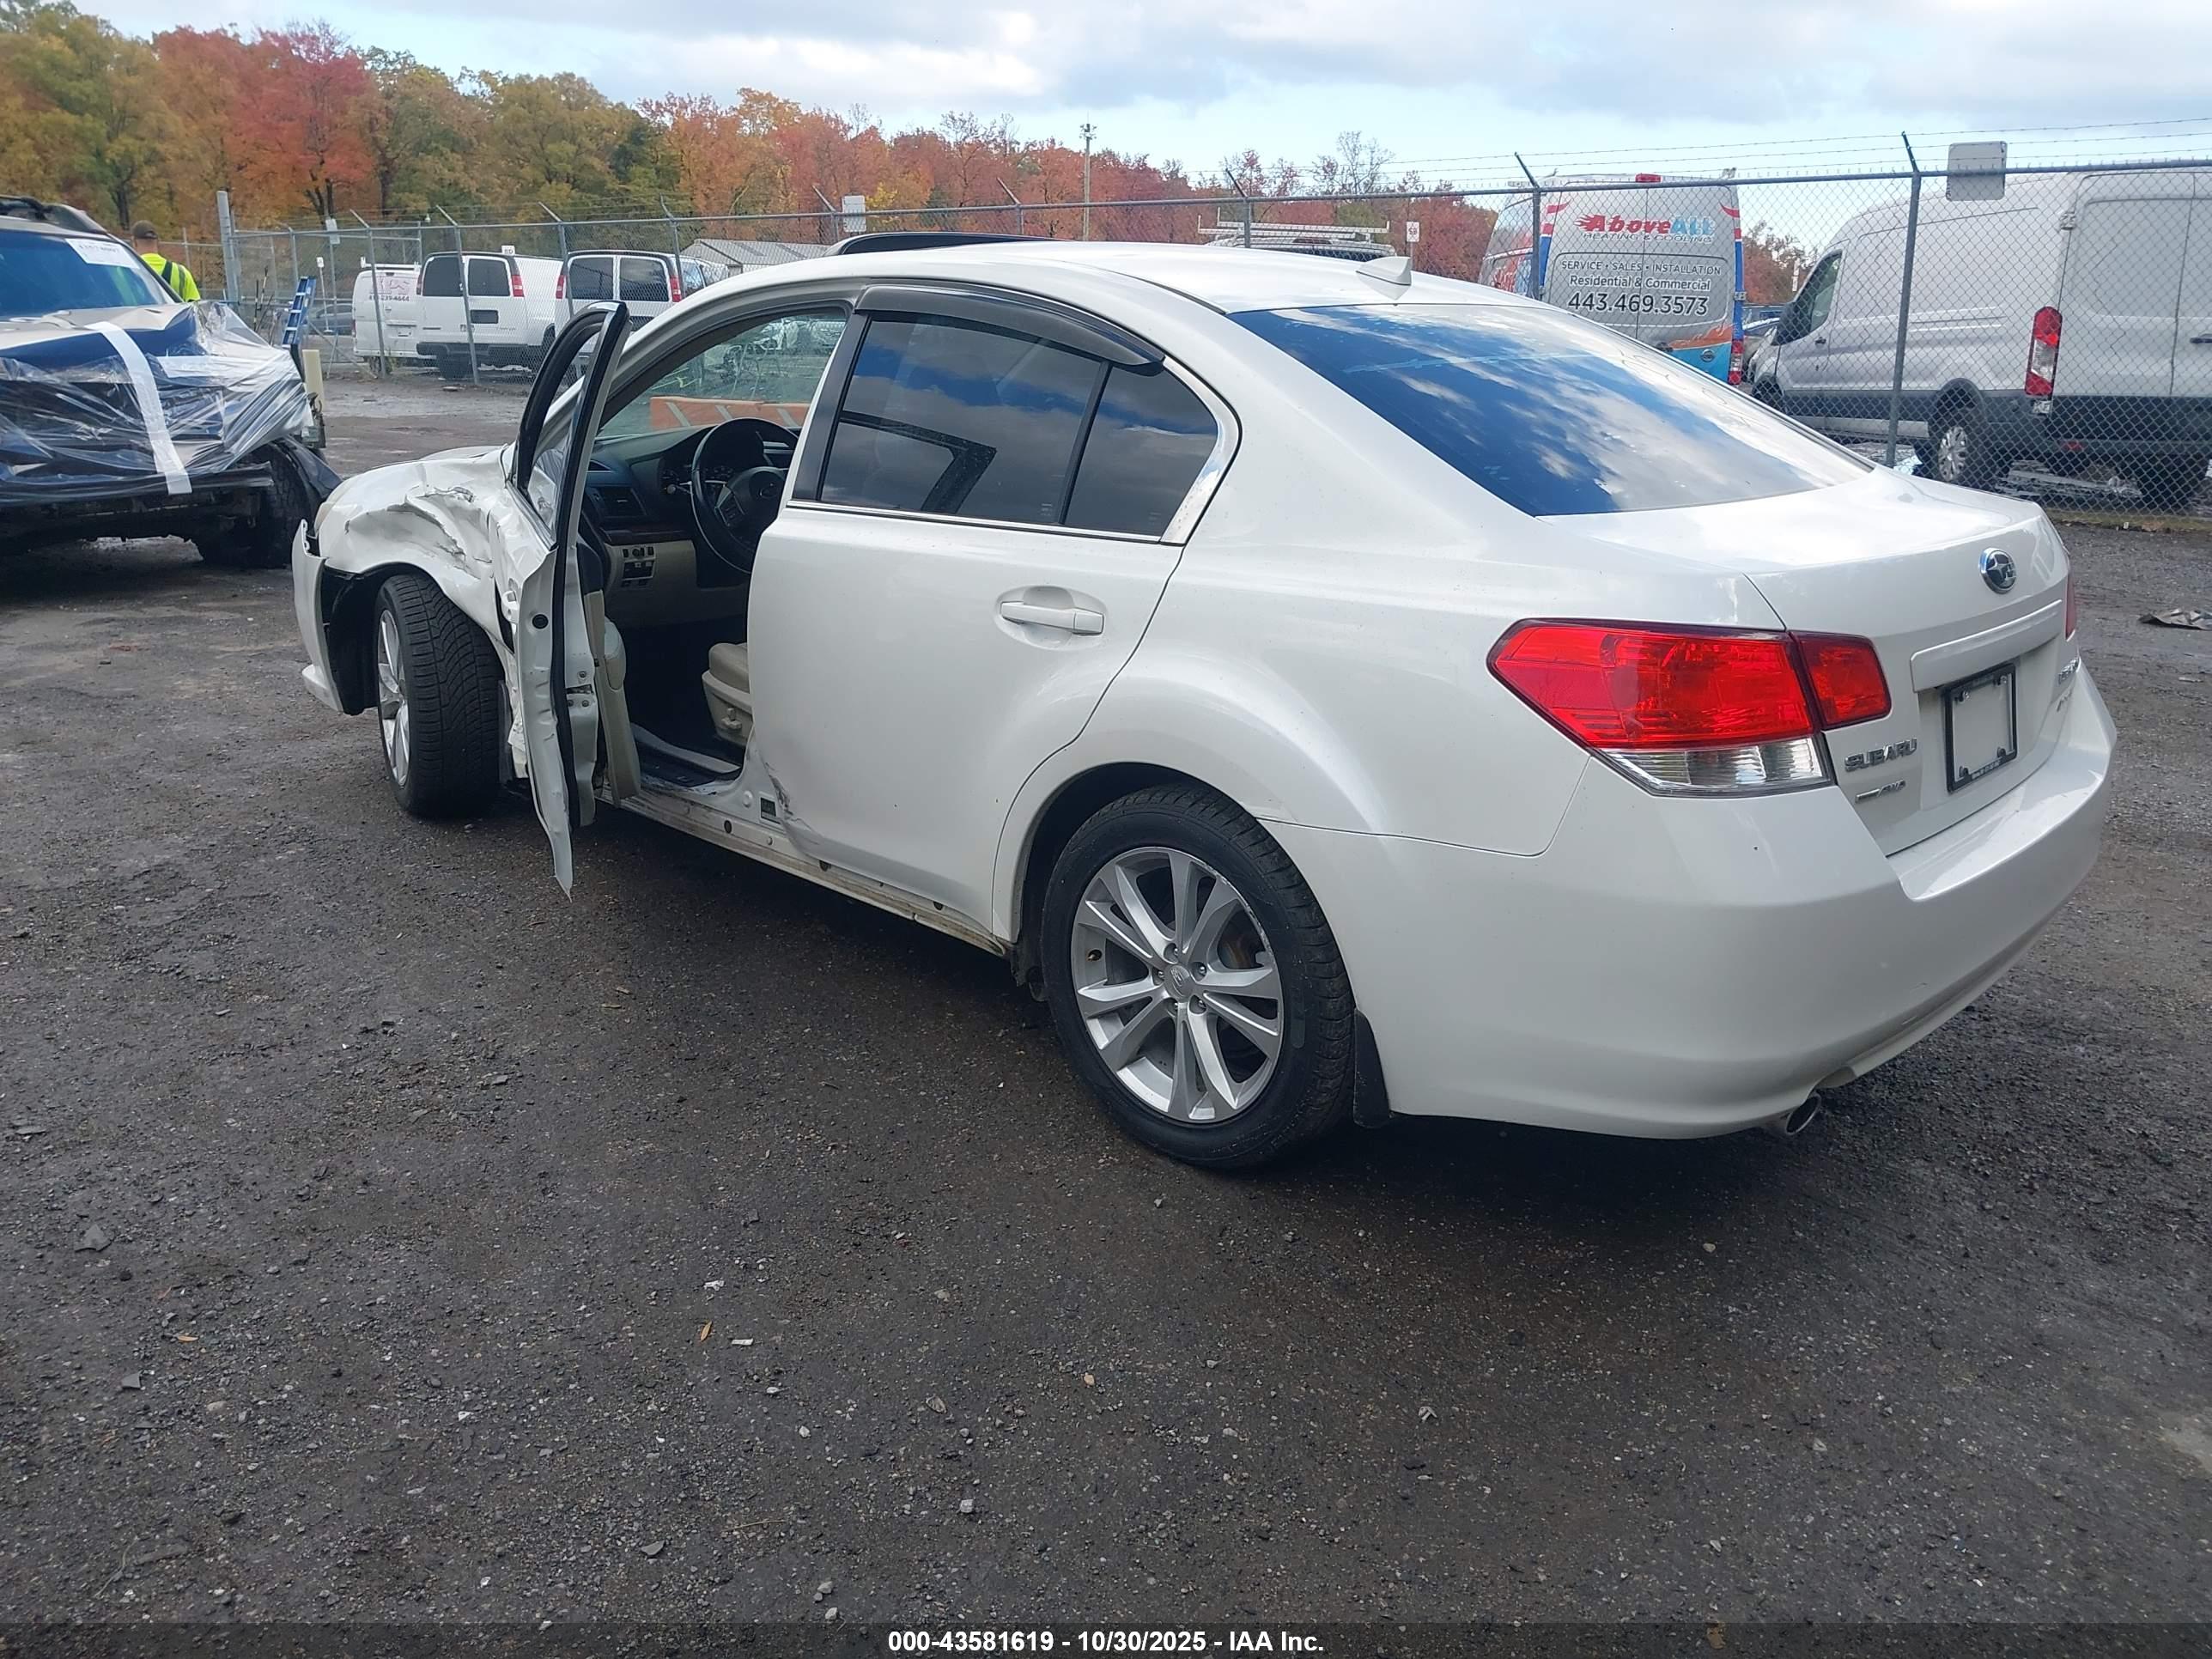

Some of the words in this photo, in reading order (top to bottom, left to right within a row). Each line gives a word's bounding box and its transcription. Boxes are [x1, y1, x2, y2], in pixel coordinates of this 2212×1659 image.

[1583, 233, 1639, 241] HEATING
[1654, 234, 1712, 243] COOLING
[1562, 261, 1602, 270] SERVICE
[1613, 263, 1642, 271] SALES
[1653, 264, 1721, 276] INSTALLATION
[1570, 275, 1631, 287] Residential
[1635, 278, 1642, 287] &
[1645, 277, 1711, 290] Commercial
[1568, 292, 1708, 315] 443.469.3573
[1844, 738, 1917, 772] SUBARU
